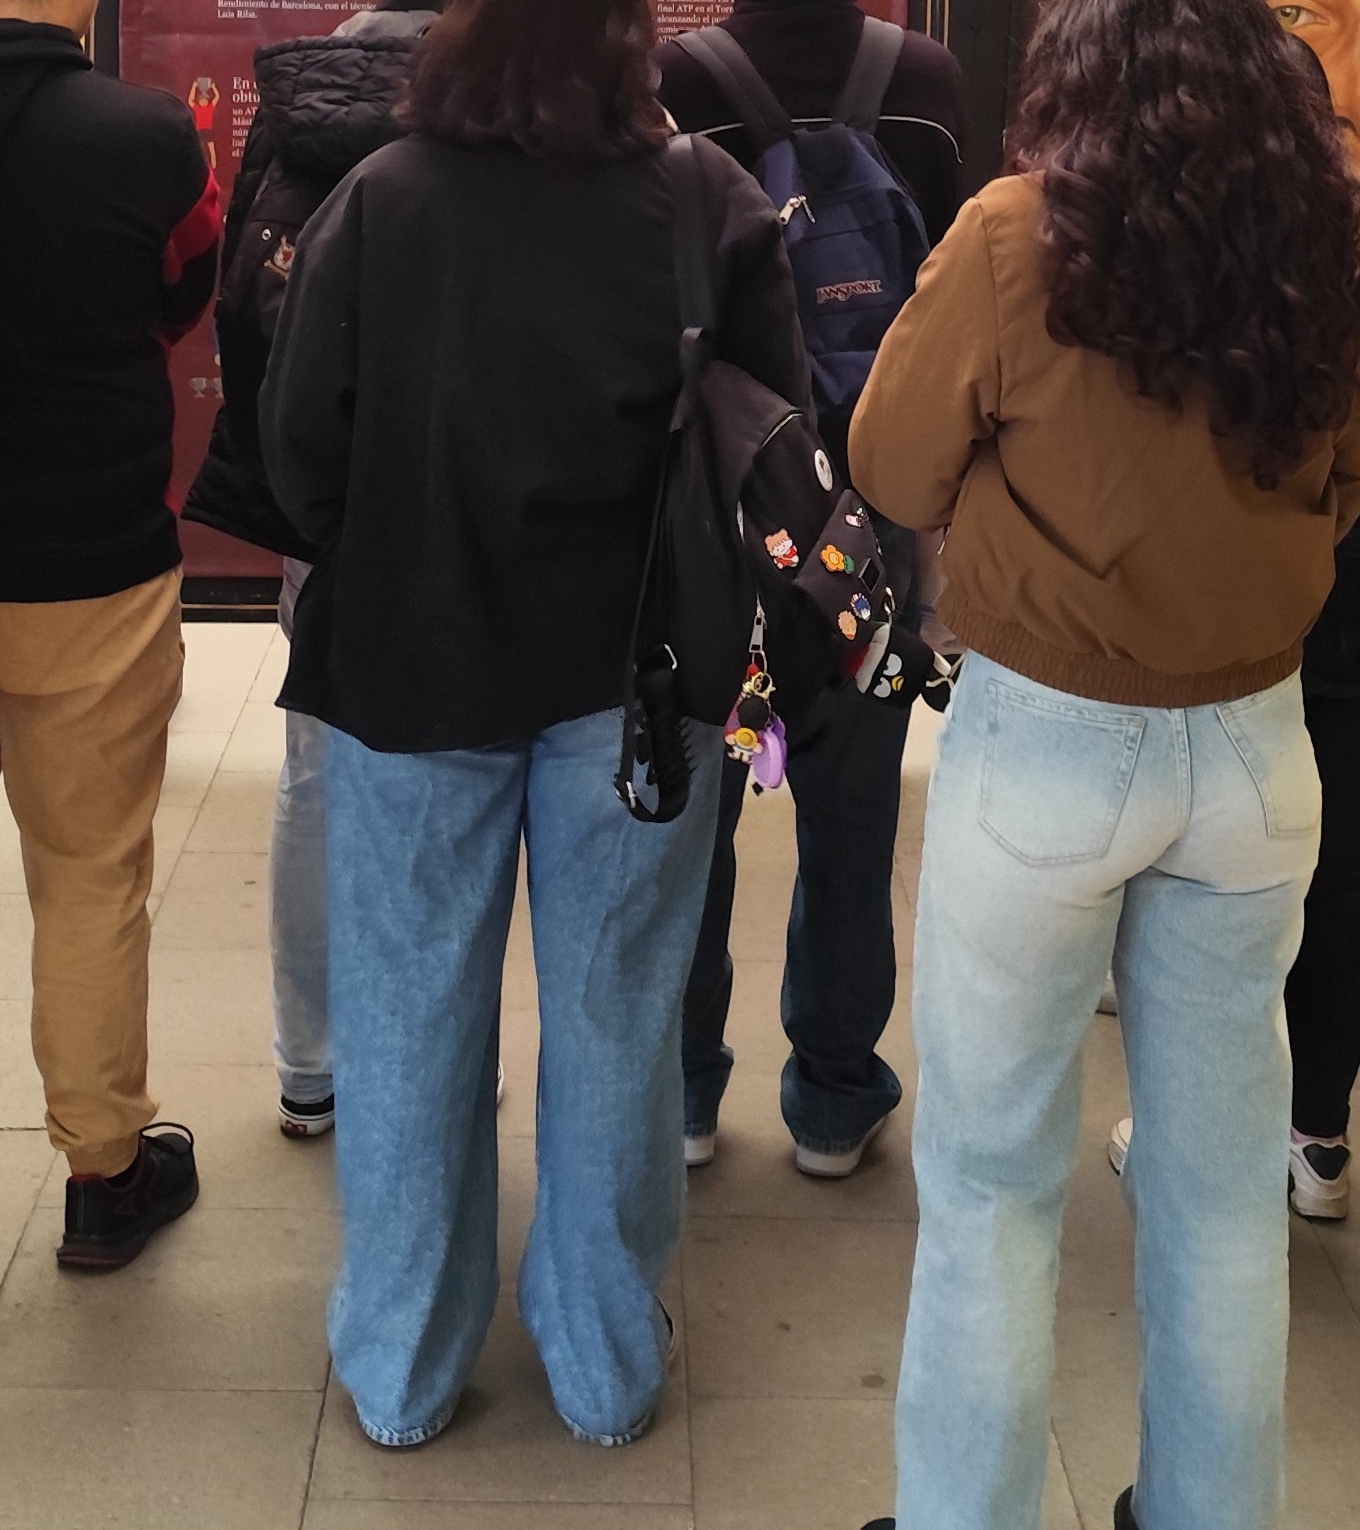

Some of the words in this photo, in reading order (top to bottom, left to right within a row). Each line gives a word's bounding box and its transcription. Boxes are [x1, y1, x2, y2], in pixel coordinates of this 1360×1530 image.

[232, 77, 250, 90] En
[232, 90, 260, 103] obtu
[816, 279, 882, 304] JANSPORT
